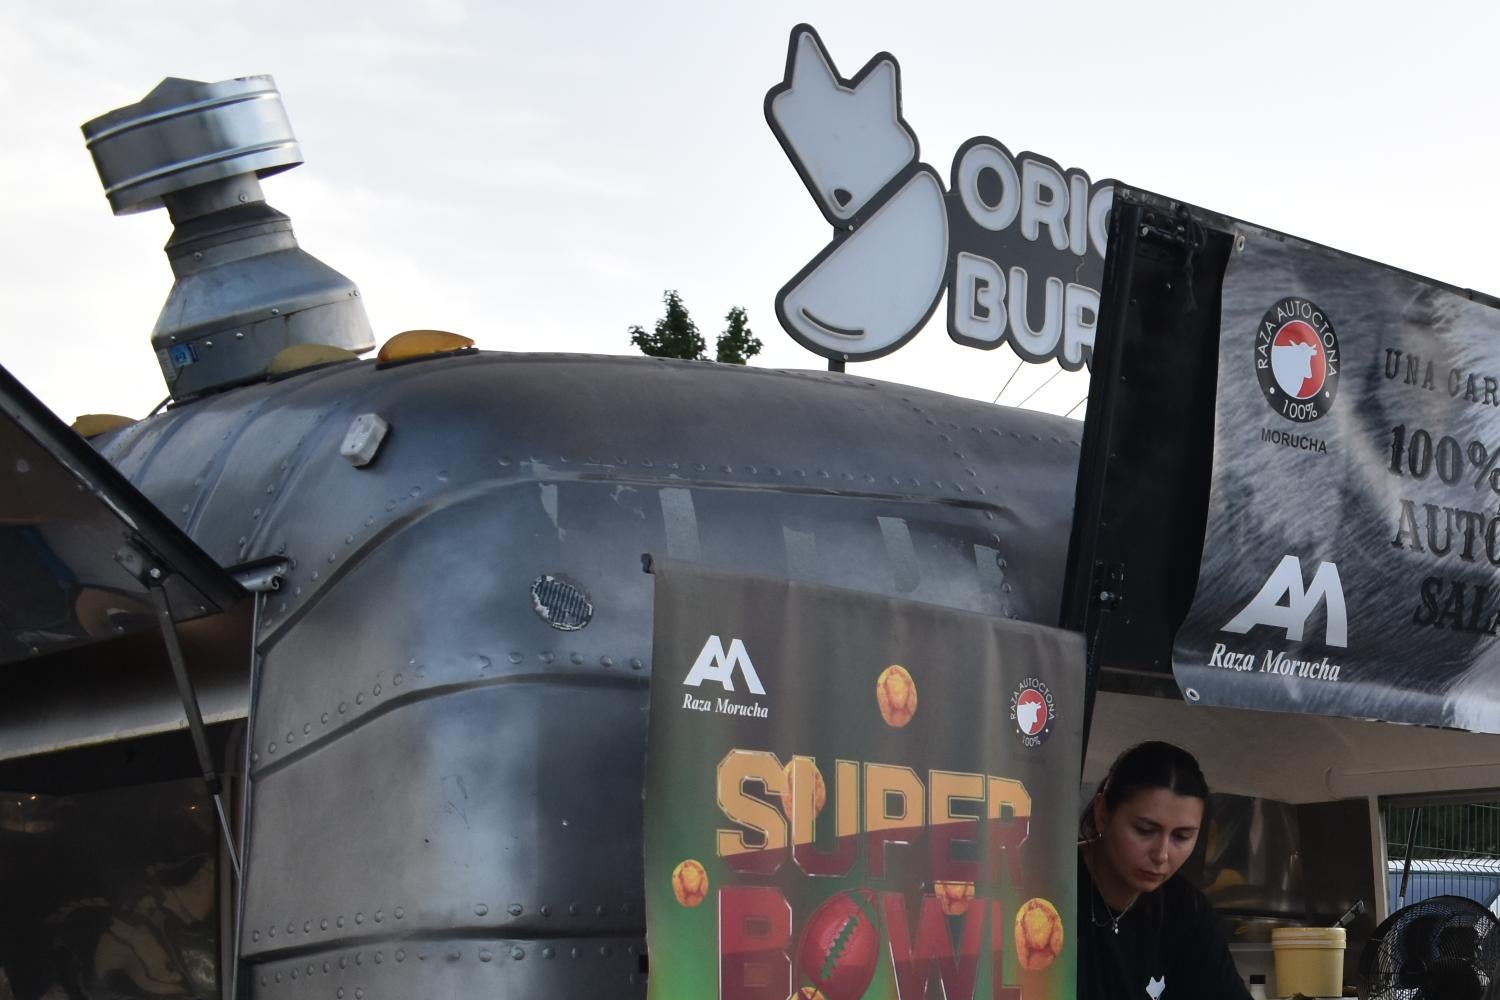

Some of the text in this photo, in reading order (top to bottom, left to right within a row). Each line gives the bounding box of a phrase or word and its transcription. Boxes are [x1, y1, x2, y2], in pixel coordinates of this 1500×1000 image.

[1257, 321, 1277, 369] RAZA
[1384, 347, 1435, 390] UNA
[1282, 400, 1318, 420] 100%
[1261, 428, 1327, 454] MORUCHA
[1208, 643, 1341, 682] Raza Morucha
[682, 693, 769, 718] Raza Morucha
[1009, 690, 1020, 720] RAZA
[1022, 735, 1041, 747] 100%
[716, 748, 1032, 889] SUPER
